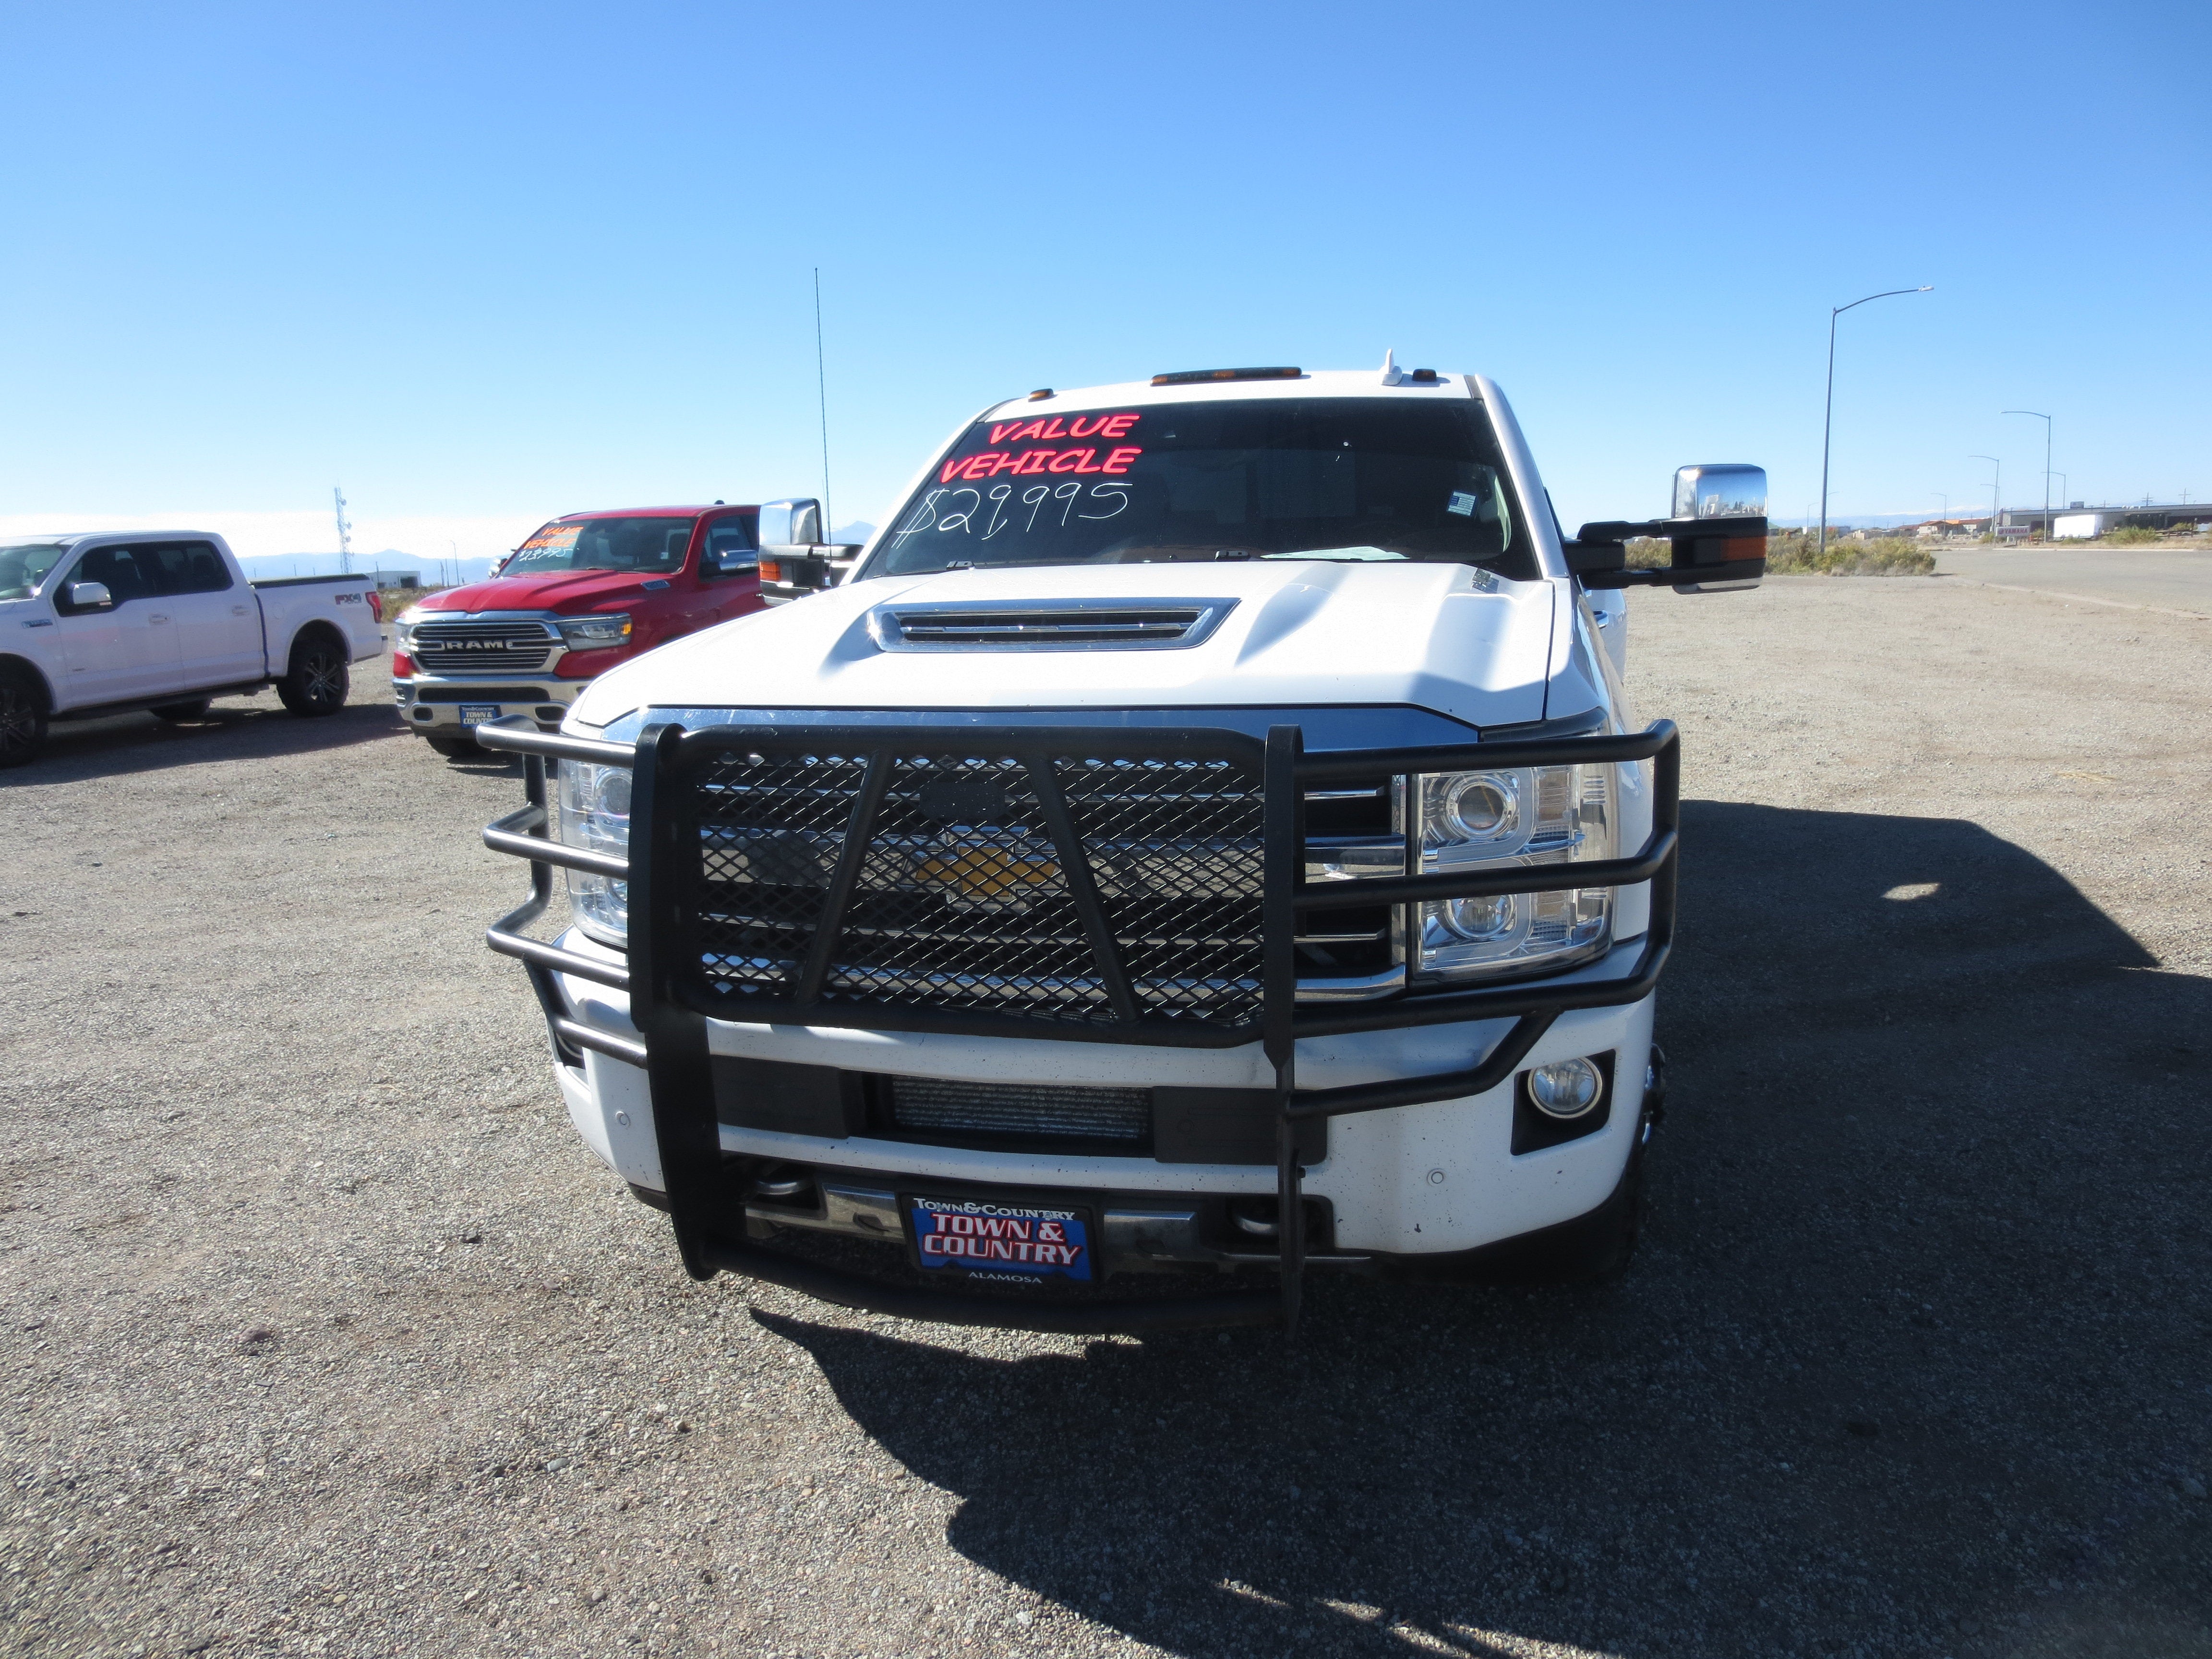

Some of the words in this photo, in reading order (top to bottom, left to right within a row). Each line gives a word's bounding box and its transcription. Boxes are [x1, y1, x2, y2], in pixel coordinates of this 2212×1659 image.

[989, 414, 1141, 445] VALUE
[940, 447, 1142, 483] VEHICLE
[541, 526, 584, 536] VALUE
[523, 538, 577, 549] VEHICLE
[335, 593, 361, 605] FX4
[446, 640, 504, 649] RAM
[932, 1214, 1031, 1240] TOWN
[1038, 1222, 1066, 1242] &
[924, 1235, 1082, 1265] COUNTRY
[969, 1272, 1042, 1284] ALAMOSA
